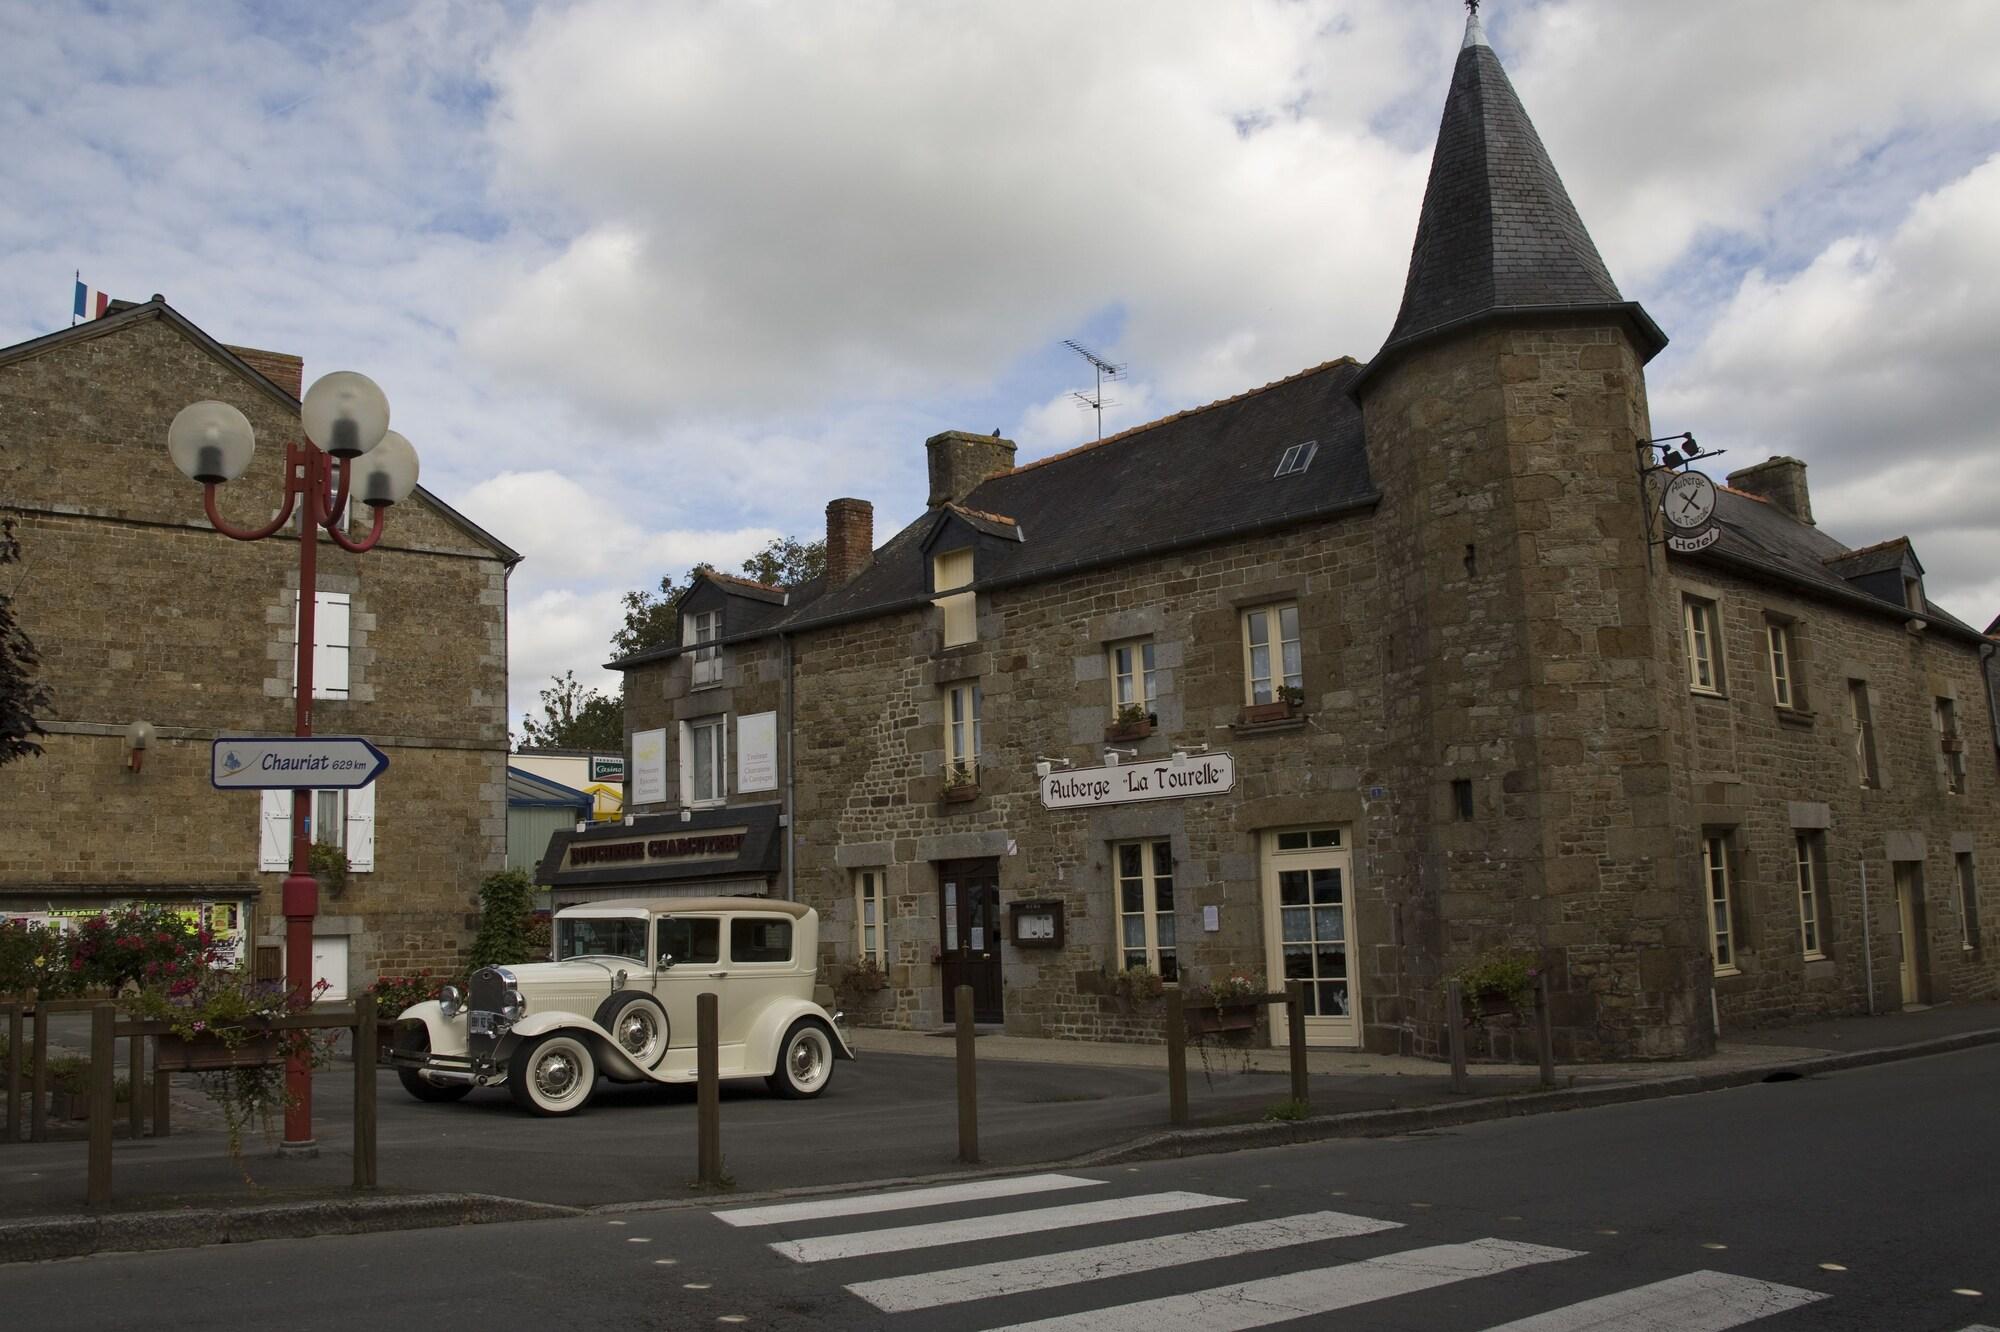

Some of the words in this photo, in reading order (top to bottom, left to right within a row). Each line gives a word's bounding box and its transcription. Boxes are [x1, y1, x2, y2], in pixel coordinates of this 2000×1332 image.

[1672, 476, 1705, 493] Auberge
[1675, 531, 1713, 550] Hotel
[262, 753, 330, 771] Chauriat
[332, 760, 353, 770] 629
[353, 760, 366, 770] km
[597, 765, 622, 773] Casino
[1050, 777, 1110, 800] Auberge
[570, 842, 645, 865] BOUCHERIE
